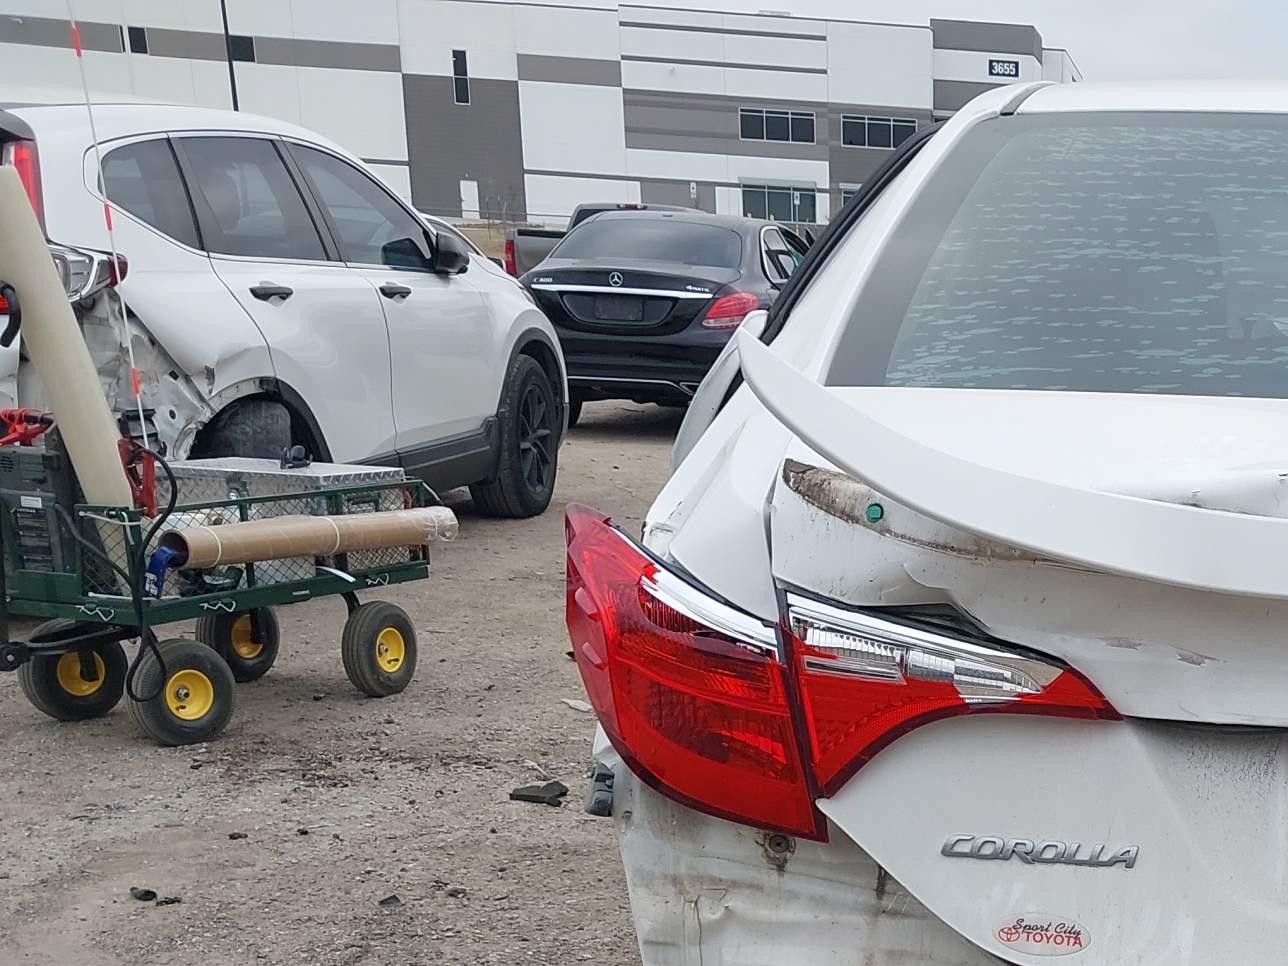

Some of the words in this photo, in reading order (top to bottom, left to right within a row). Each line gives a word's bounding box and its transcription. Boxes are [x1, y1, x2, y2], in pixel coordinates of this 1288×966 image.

[991, 61, 1016, 75] 3655
[941, 834, 1140, 868] COROLLA
[1012, 918, 1052, 934] Sport
[1055, 922, 1082, 936] City
[1024, 931, 1083, 948] TOYOTA
